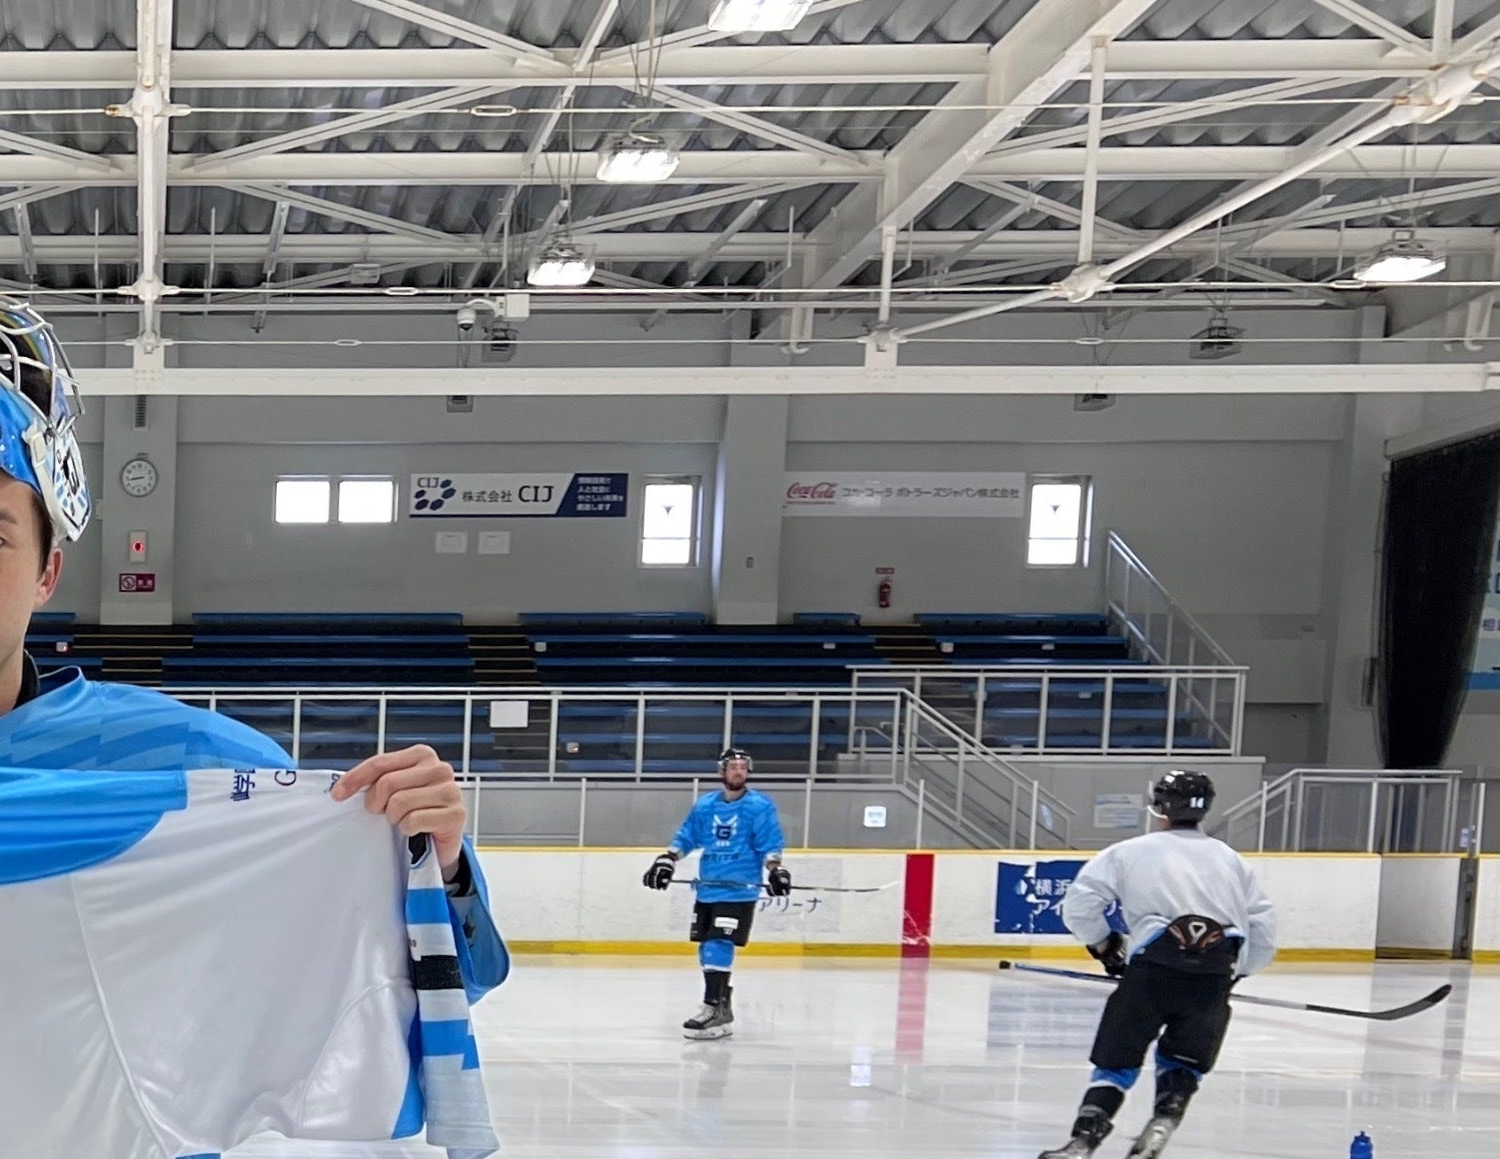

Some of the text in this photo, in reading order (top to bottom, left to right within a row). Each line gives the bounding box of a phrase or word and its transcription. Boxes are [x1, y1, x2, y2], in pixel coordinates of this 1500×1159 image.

[417, 477, 440, 488] CIJ
[462, 485, 554, 503] 株式会社 CIJ
